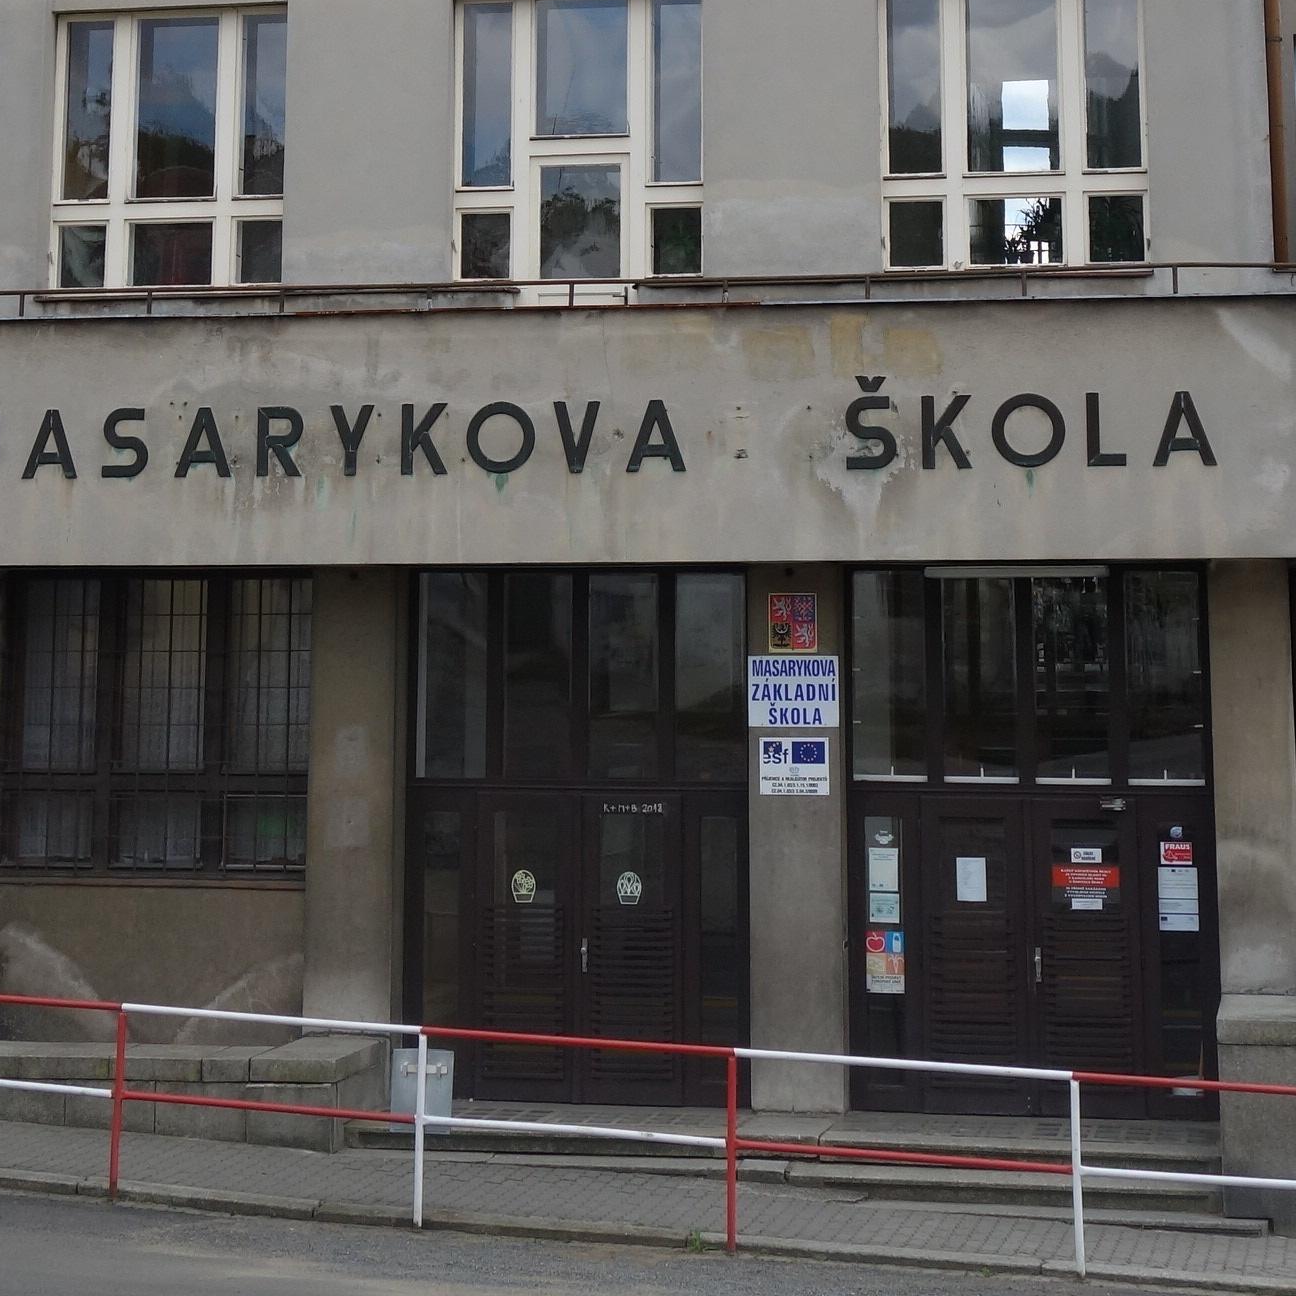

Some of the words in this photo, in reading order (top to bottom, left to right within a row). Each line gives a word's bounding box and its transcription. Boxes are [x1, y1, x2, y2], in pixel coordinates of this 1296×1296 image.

[846, 375, 1219, 471] ŠKOLA
[752, 659, 836, 677] MASARYKOVA
[751, 678, 836, 701] ZÁKLADNÍ
[768, 702, 823, 725] ŠKOLA
[763, 748, 789, 764] esf
